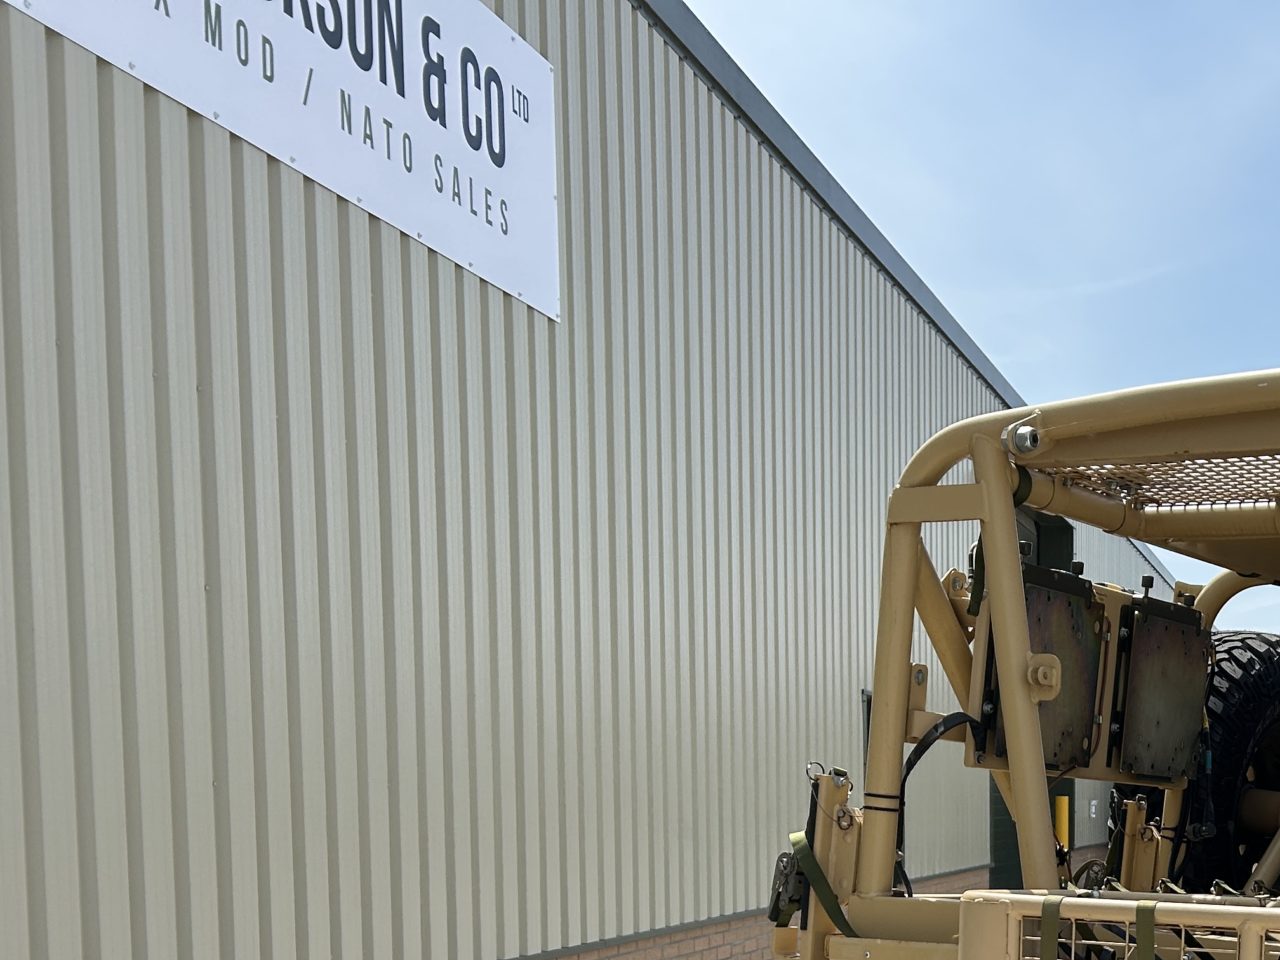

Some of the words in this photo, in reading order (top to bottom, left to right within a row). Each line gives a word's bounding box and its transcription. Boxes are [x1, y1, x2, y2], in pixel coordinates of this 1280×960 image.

[203, 0, 275, 83] MOD
[339, 88, 413, 173] NATO
[433, 153, 509, 236] SALES
[421, 15, 448, 129] &
[460, 46, 506, 168] CO
[511, 84, 530, 123] LTD
